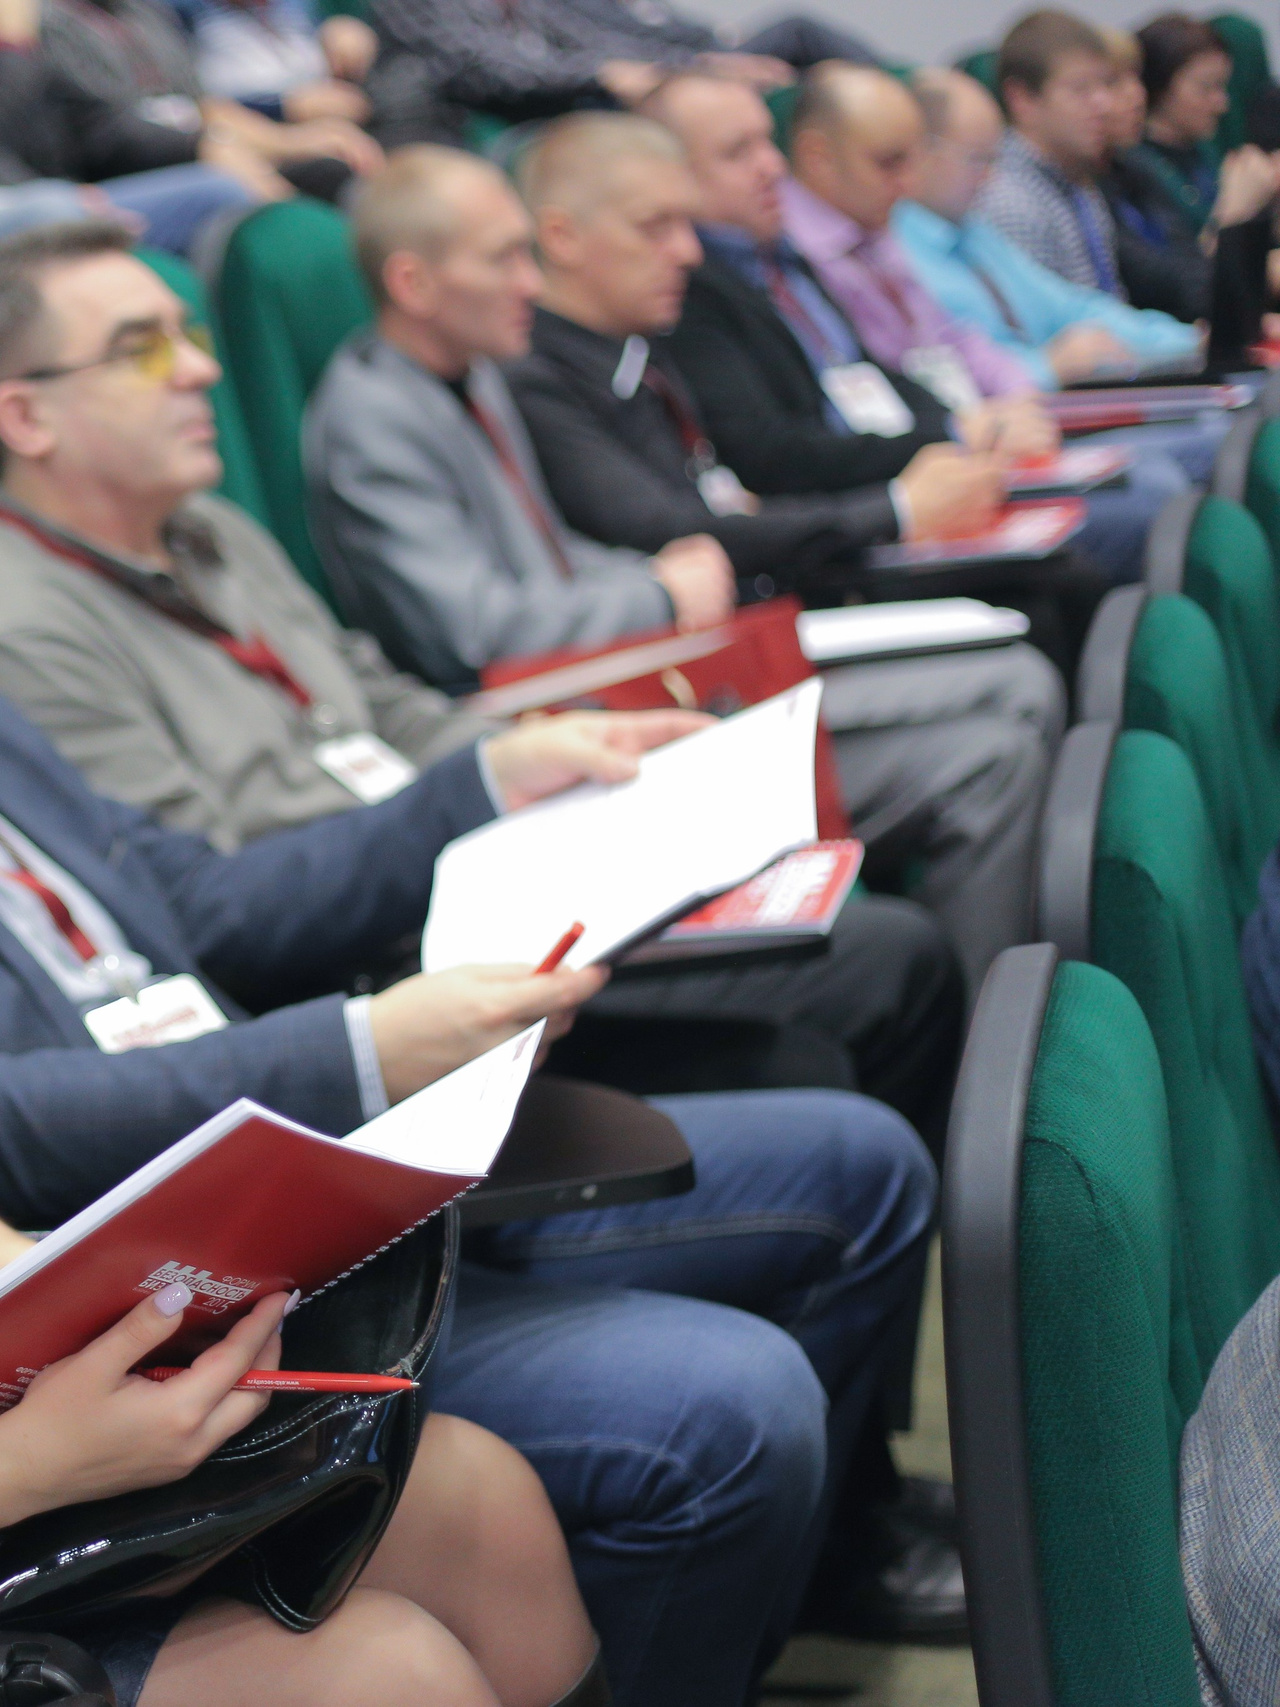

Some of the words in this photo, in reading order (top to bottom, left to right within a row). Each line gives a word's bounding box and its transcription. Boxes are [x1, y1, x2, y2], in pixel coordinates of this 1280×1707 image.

[152, 1268, 246, 1299] БЕЗОПАСНОСТЬ
[222, 1275, 261, 1289] ФОРУМ
[202, 1297, 235, 1314] 2015
